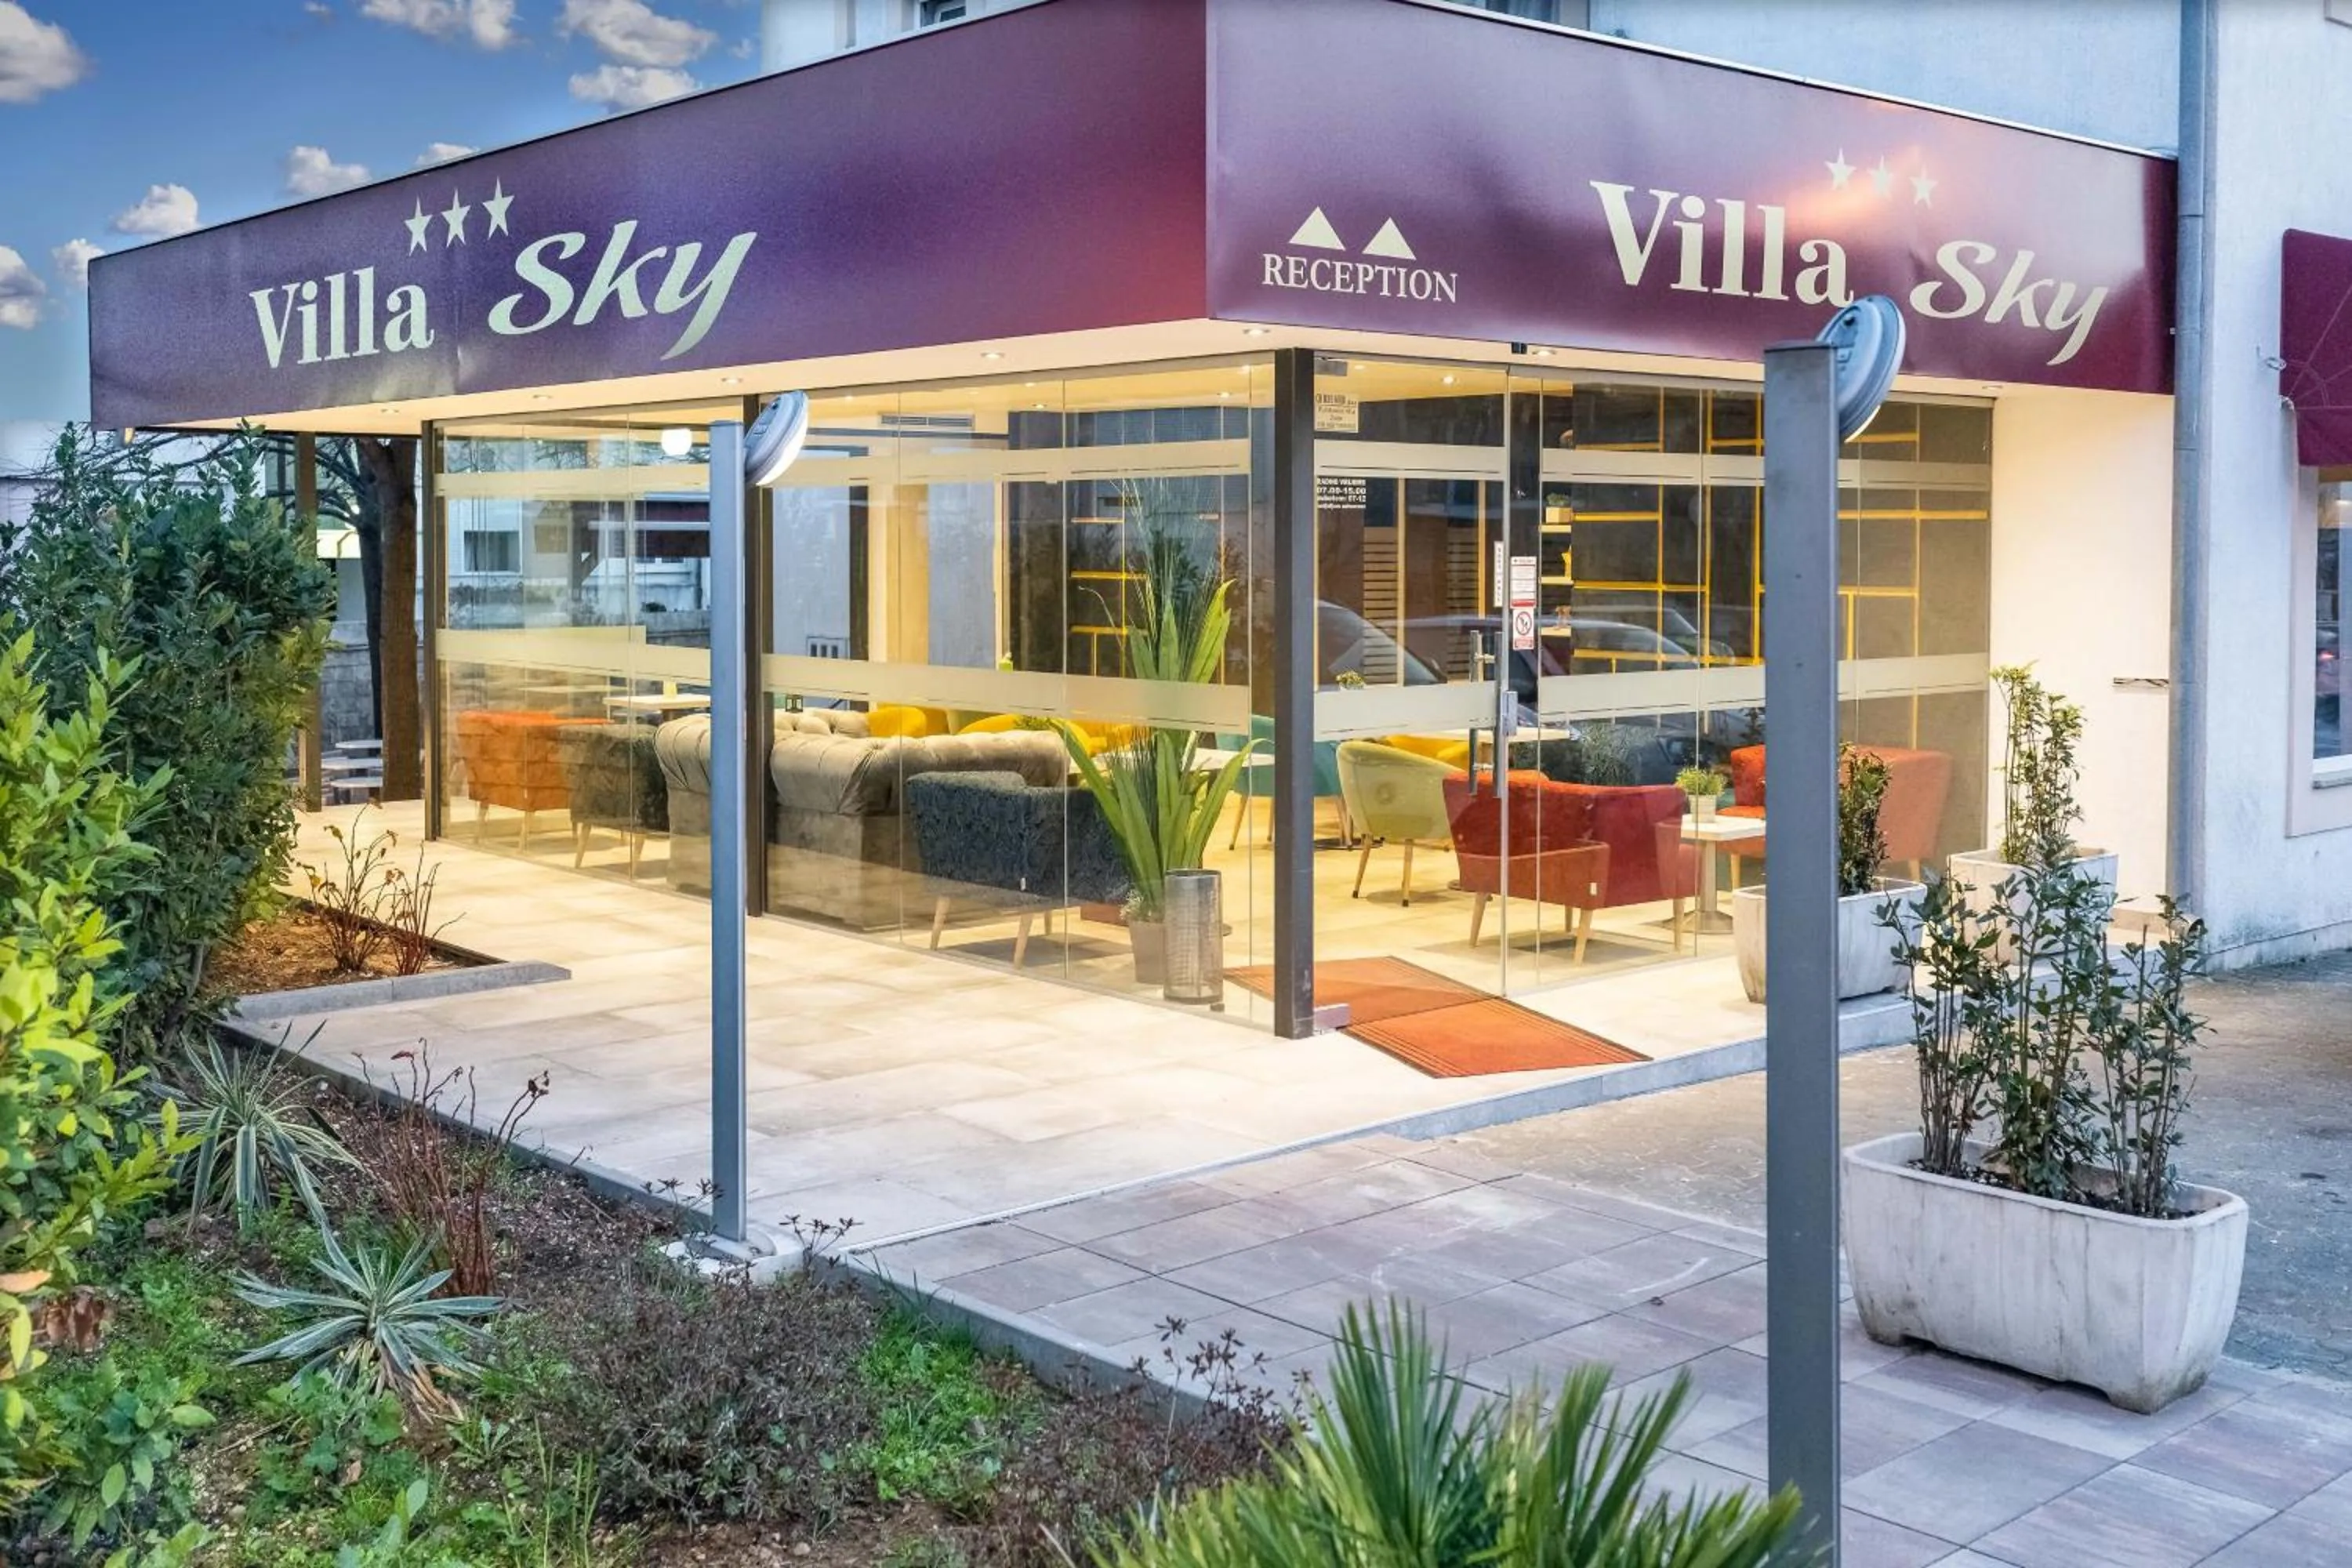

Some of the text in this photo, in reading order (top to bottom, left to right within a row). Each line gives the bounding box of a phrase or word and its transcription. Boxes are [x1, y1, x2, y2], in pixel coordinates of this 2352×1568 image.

[249, 220, 758, 369] Villa Sky
[1261, 253, 1458, 303] RECEPTION
[1589, 180, 2110, 366] Villa Sky
